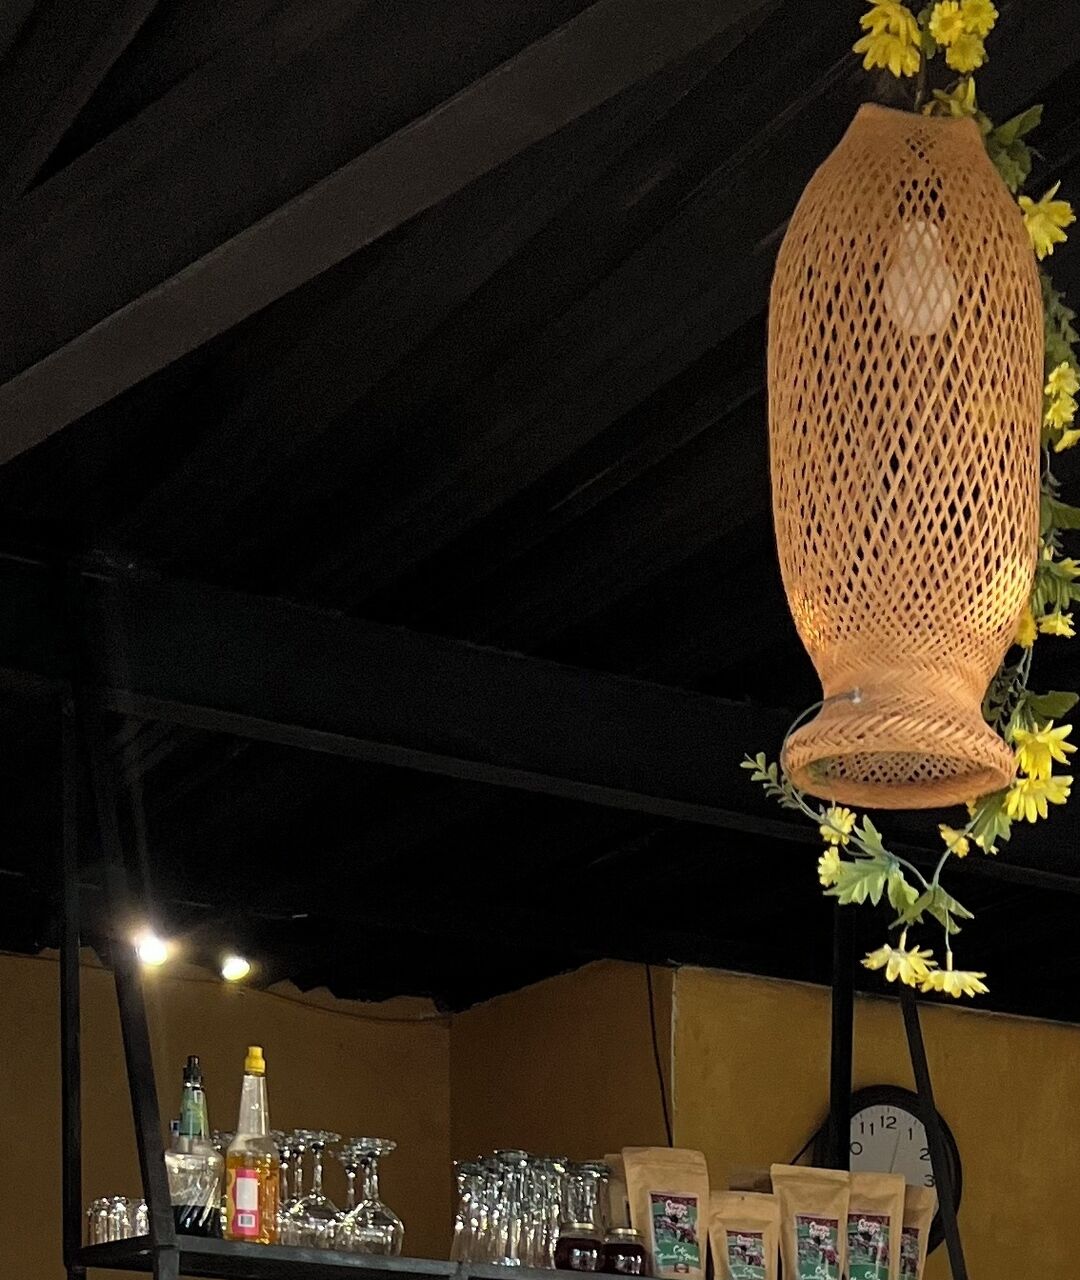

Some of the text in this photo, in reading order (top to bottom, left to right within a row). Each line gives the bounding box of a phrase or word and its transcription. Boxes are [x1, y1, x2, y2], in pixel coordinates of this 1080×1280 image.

[860, 1121, 874, 1136] 11
[880, 1115, 897, 1130] 12
[908, 1127, 913, 1140] 1
[919, 1148, 930, 1161] 2
